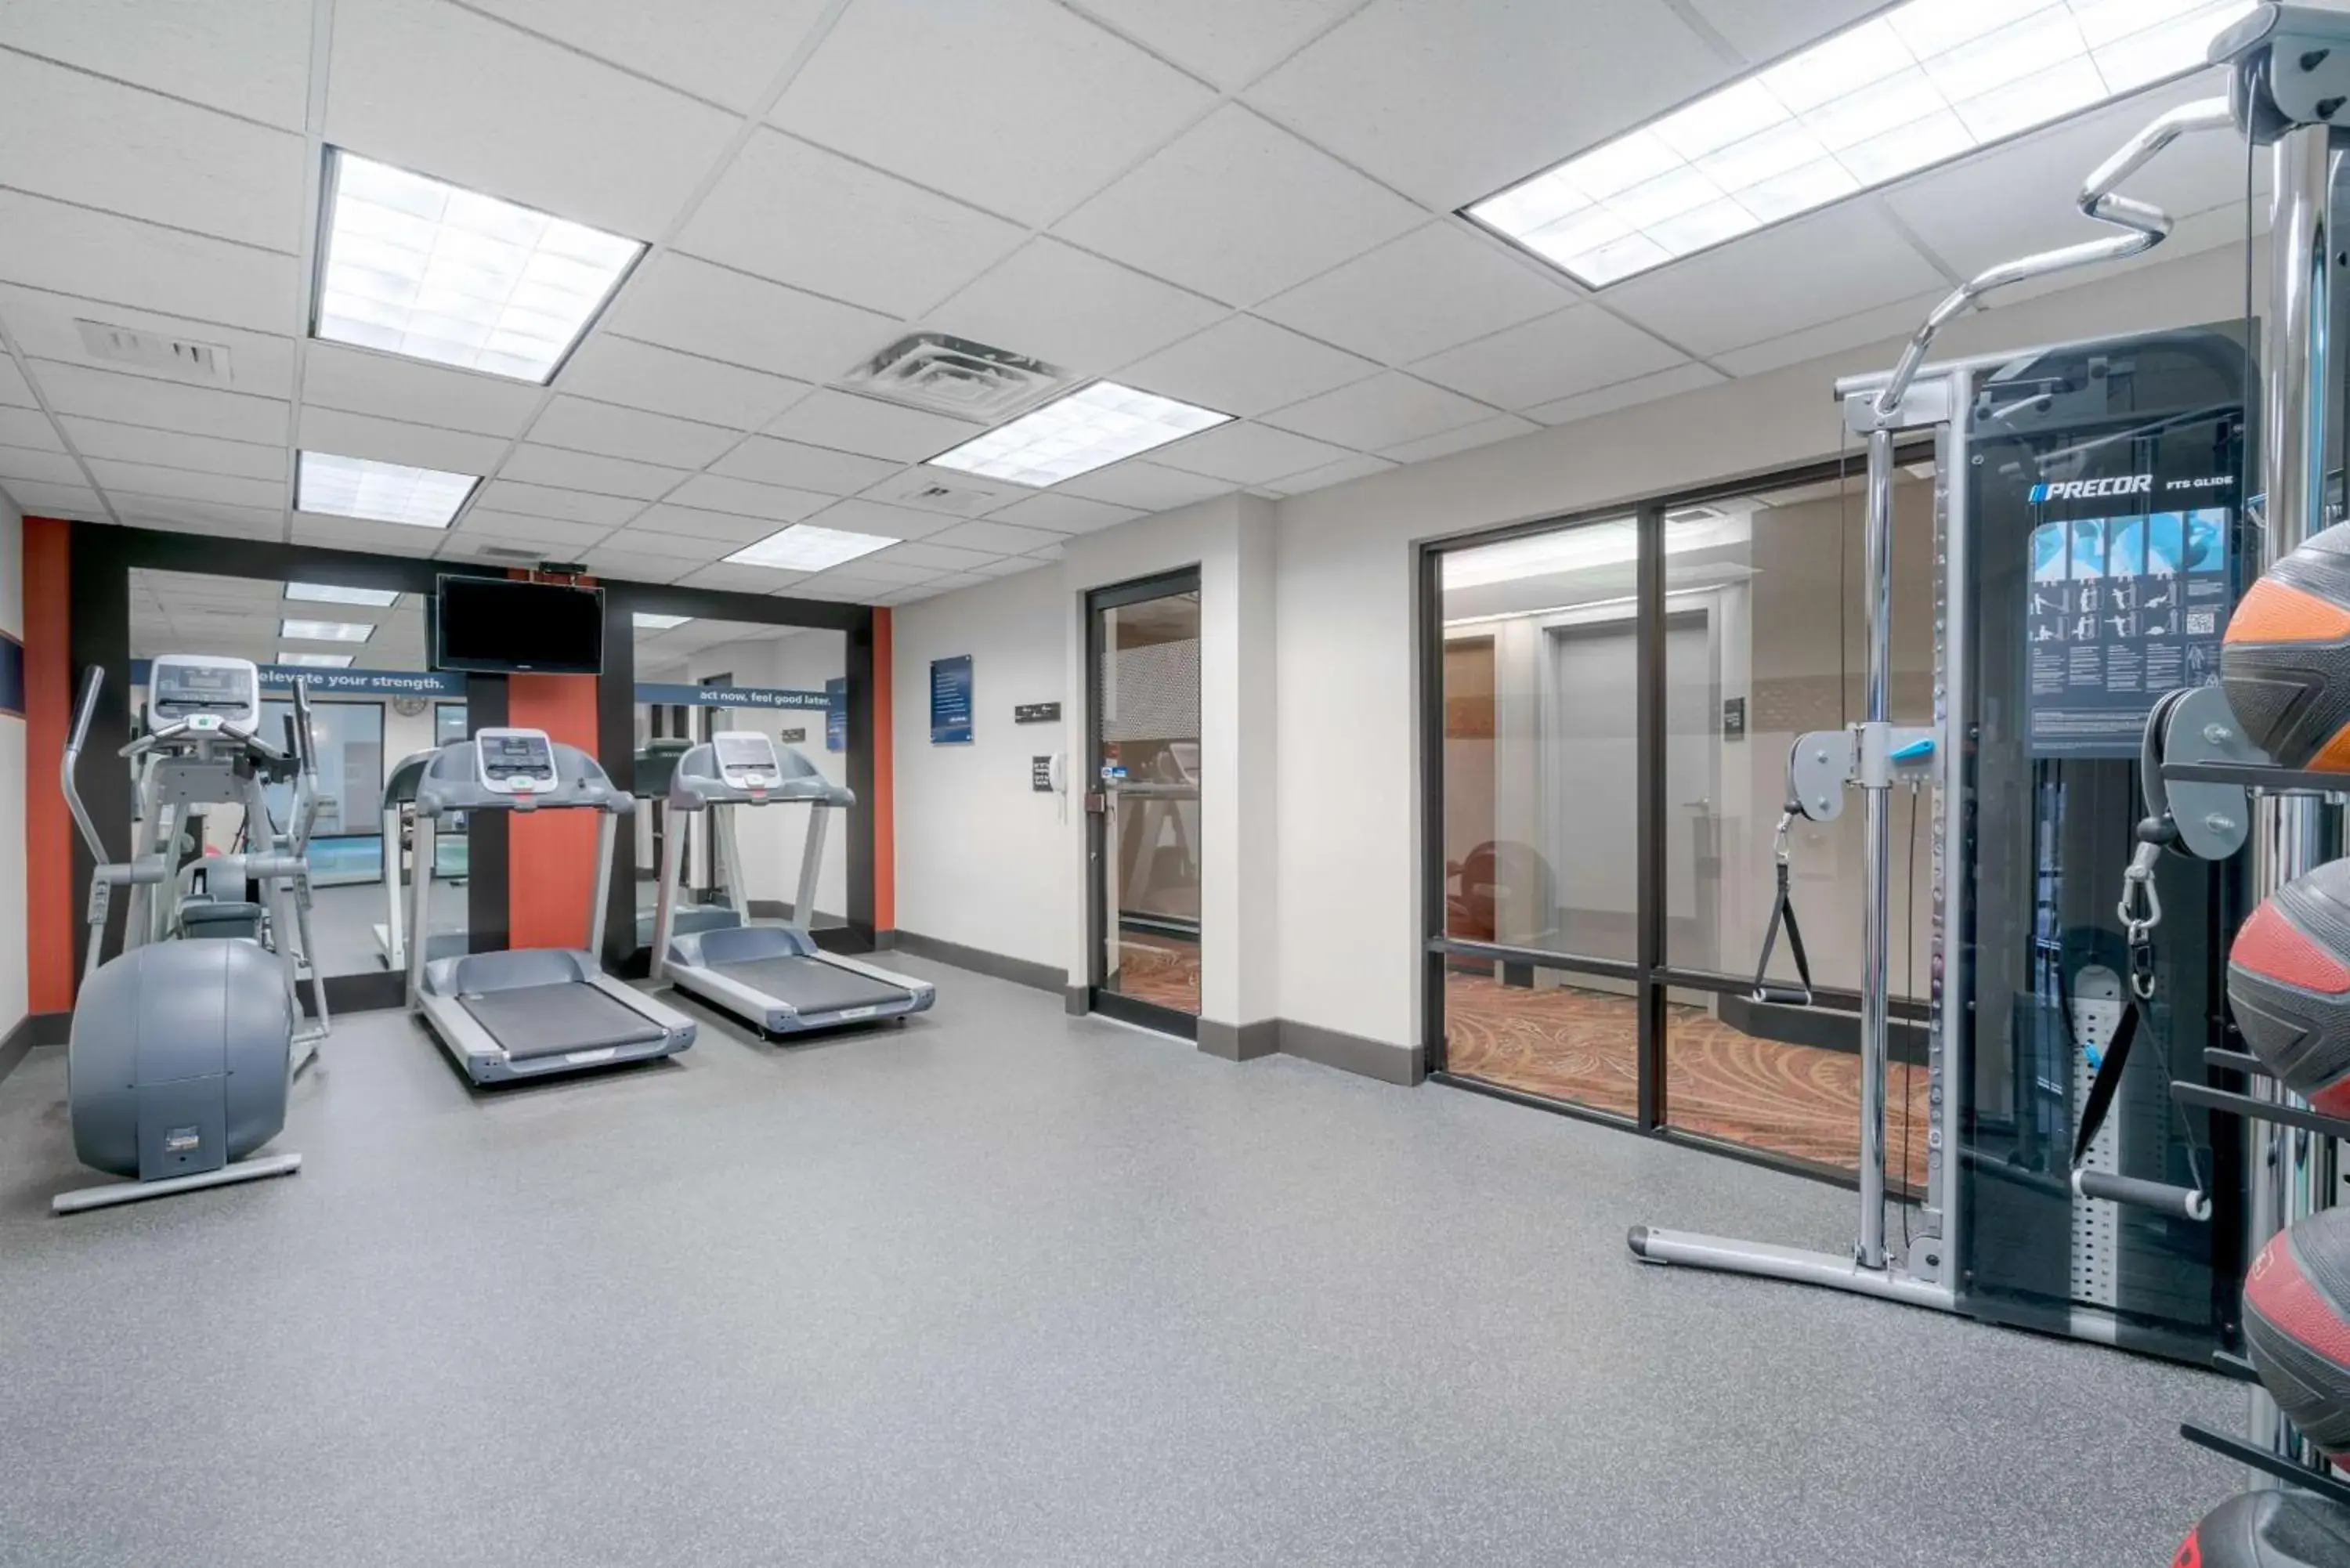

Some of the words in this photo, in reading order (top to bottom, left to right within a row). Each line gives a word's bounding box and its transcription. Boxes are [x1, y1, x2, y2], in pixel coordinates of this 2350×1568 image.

[2193, 475, 2233, 486] GLIDE
[2045, 475, 2153, 501] PRECOR
[328, 676, 367, 687] your
[372, 676, 444, 690] strength.
[700, 691, 718, 699] act
[751, 692, 772, 702] feel
[775, 695, 803, 706] good
[804, 695, 831, 706] later.
